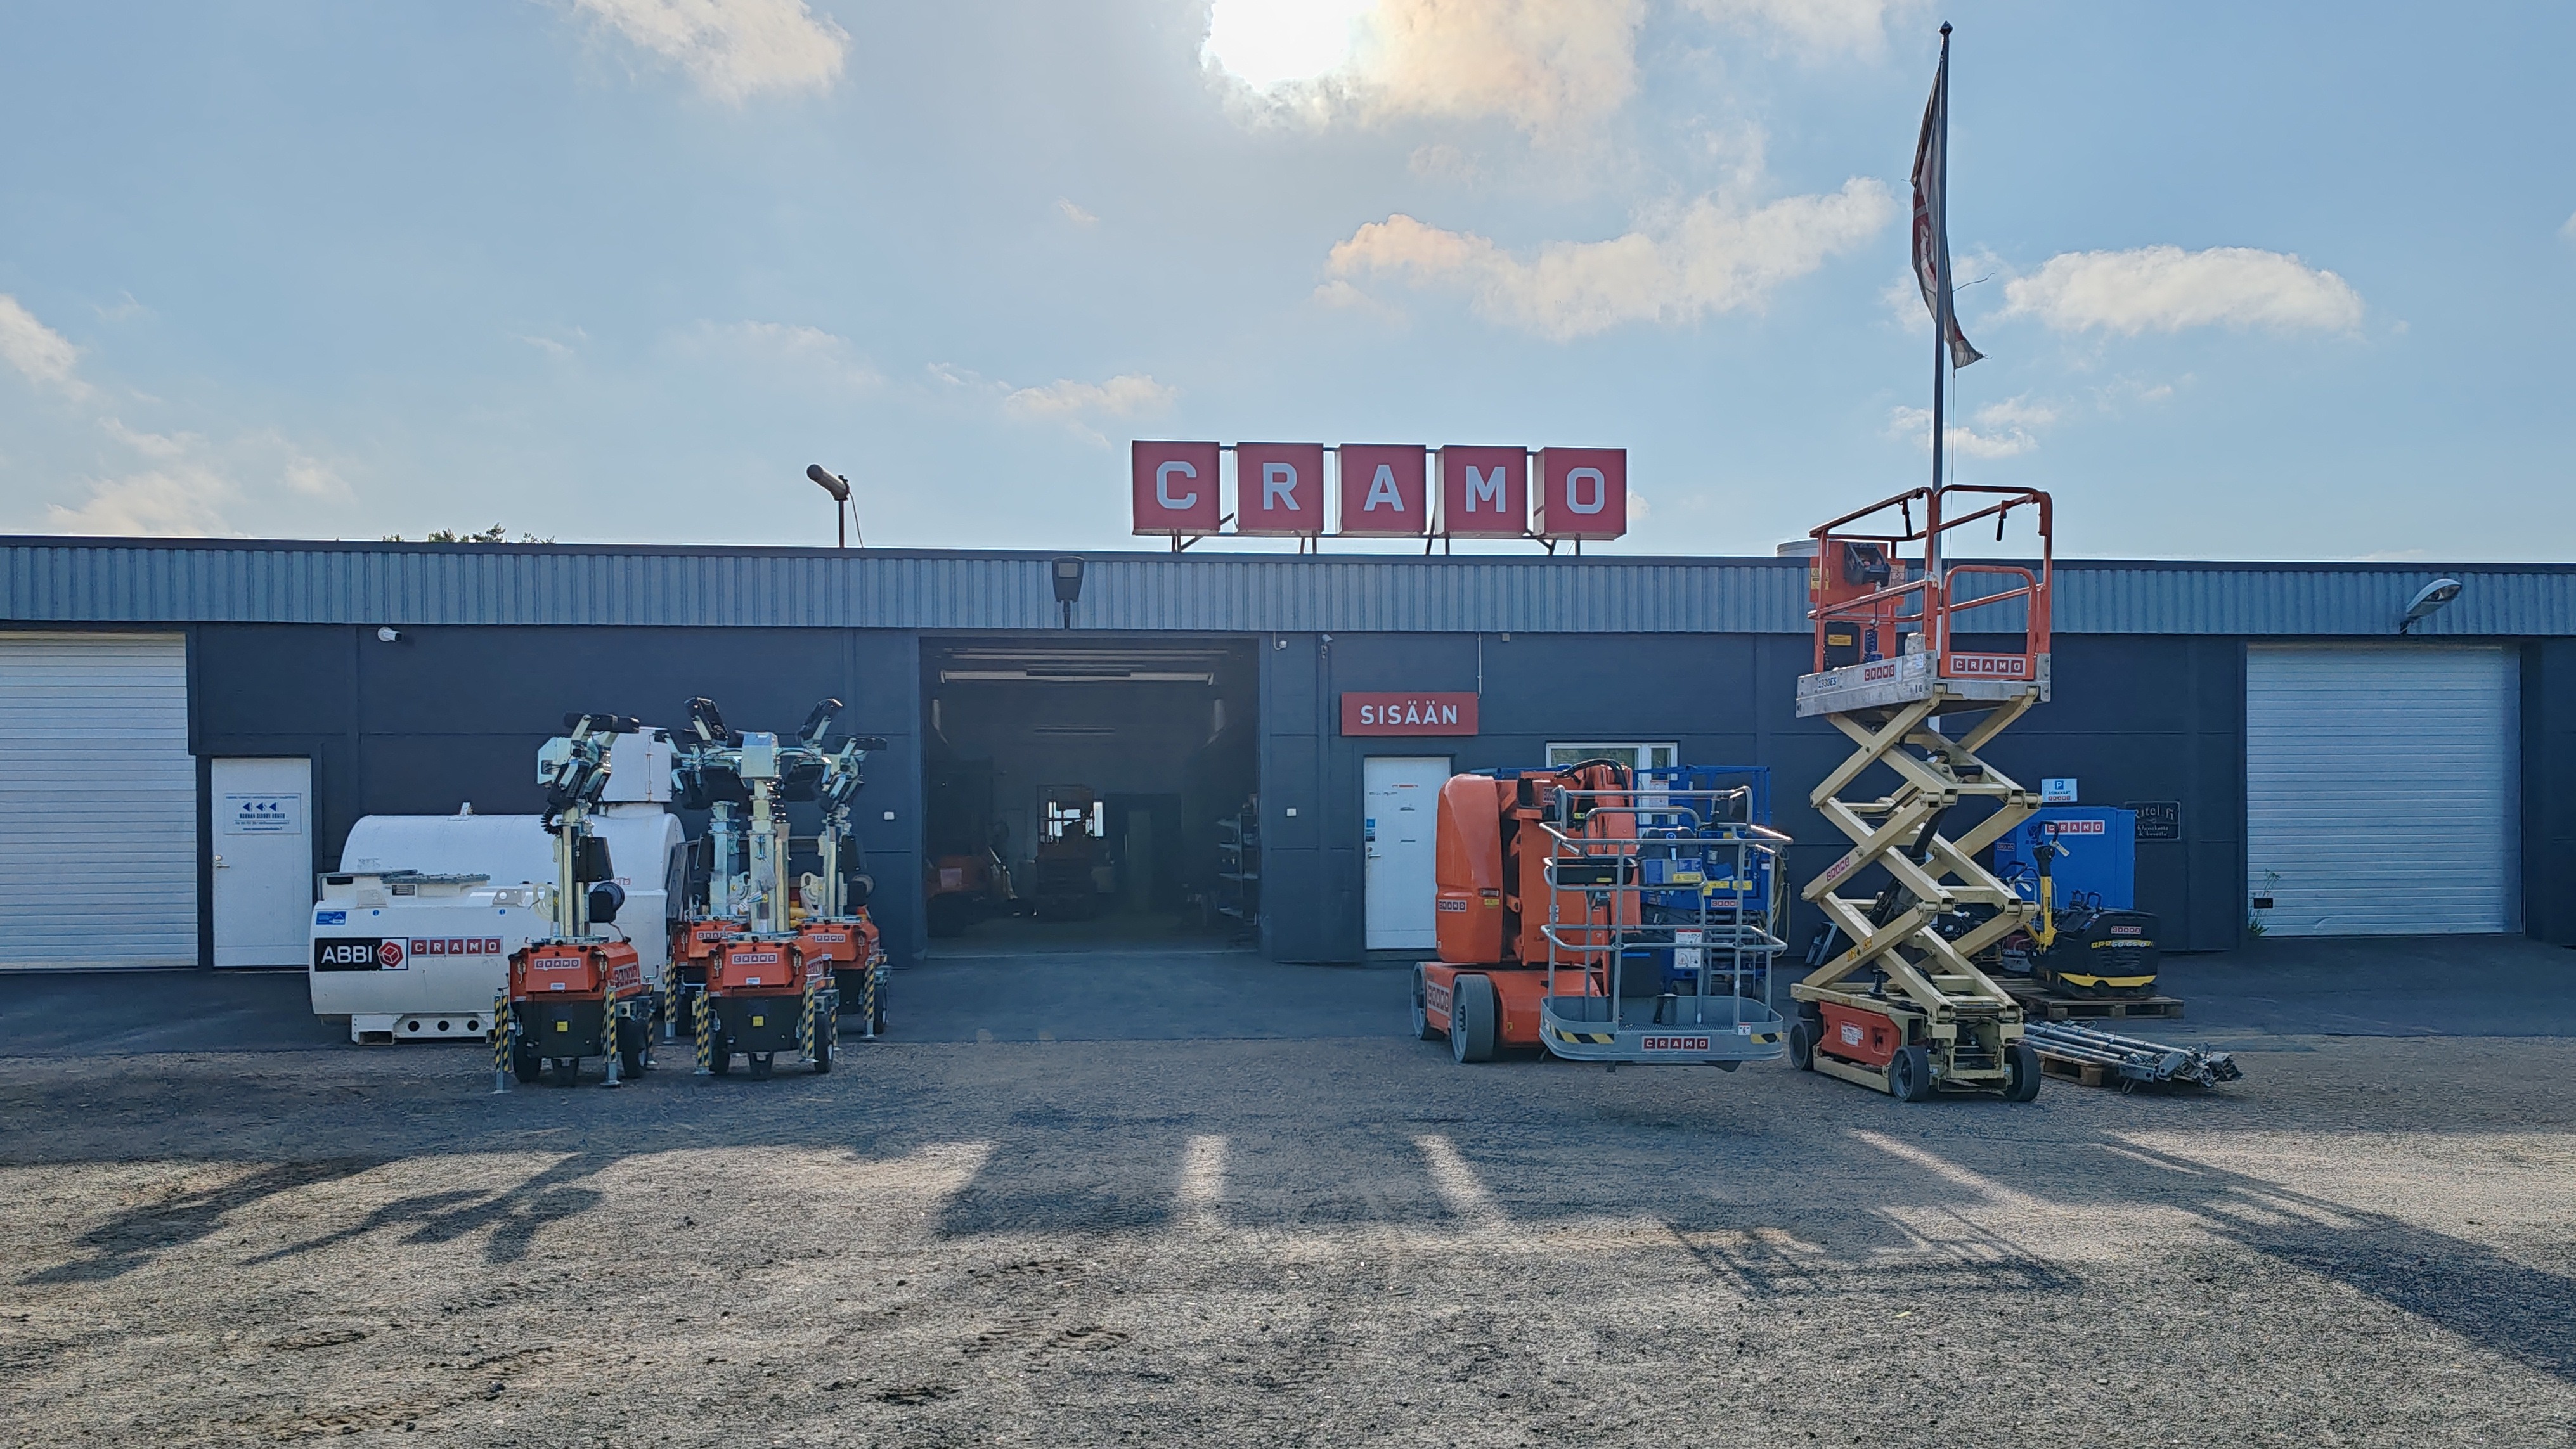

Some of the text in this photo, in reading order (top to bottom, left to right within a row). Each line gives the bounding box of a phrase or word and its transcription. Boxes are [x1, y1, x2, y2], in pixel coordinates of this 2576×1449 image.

[1153, 458, 1608, 517] CRAMO
[1955, 659, 2021, 672] CRAMO
[1865, 666, 1894, 679] CRAMO
[1360, 700, 1457, 724] SISÄÄN
[2056, 781, 2062, 789] P
[2048, 823, 2101, 832] CRAMO
[320, 941, 498, 964] ABBI CRAMO
[734, 953, 775, 962] CRAMO
[1646, 1040, 1707, 1048] CRAMO
